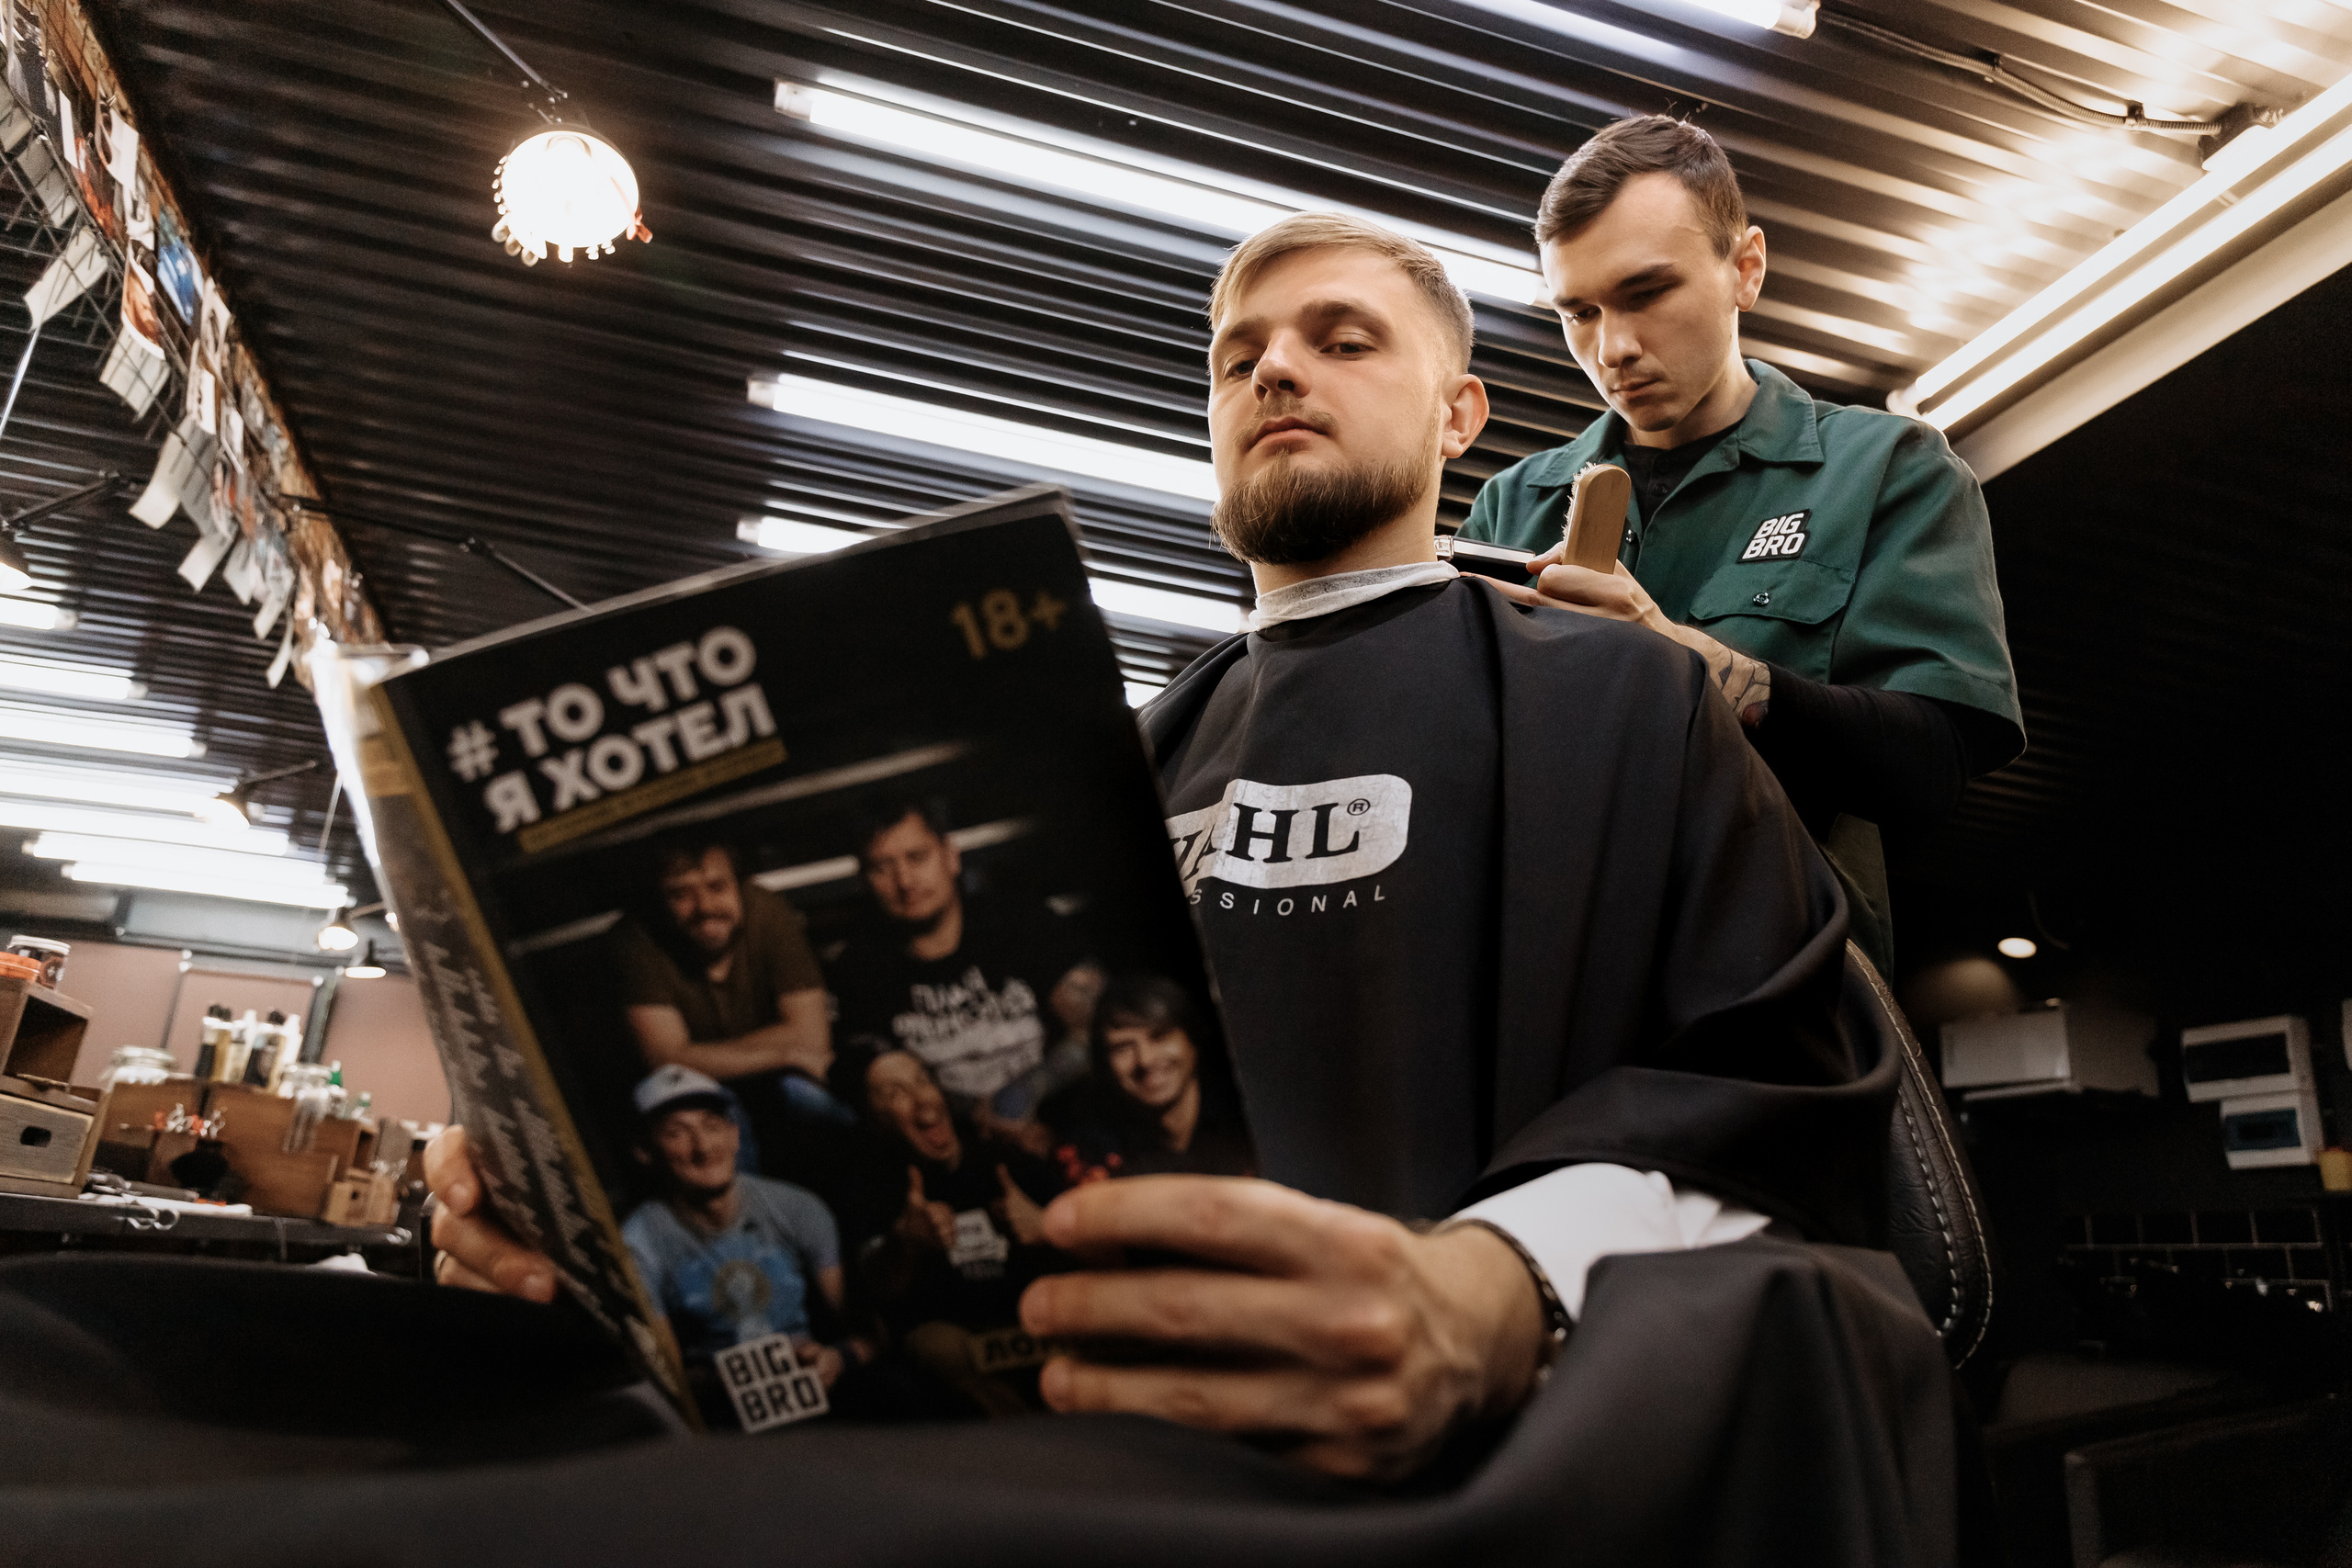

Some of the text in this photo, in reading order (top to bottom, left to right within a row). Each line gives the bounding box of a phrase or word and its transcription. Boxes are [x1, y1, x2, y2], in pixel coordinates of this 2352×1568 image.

[1742, 533, 1805, 559] BRO
[1753, 513, 1804, 539] BIG
[950, 589, 1067, 660] 18+
[605, 625, 757, 713] ЧТО
[482, 768, 543, 834] Я
[537, 682, 777, 812] ХОТЕЛ
[723, 1341, 791, 1387] BIG
[740, 1375, 820, 1423] BRO
